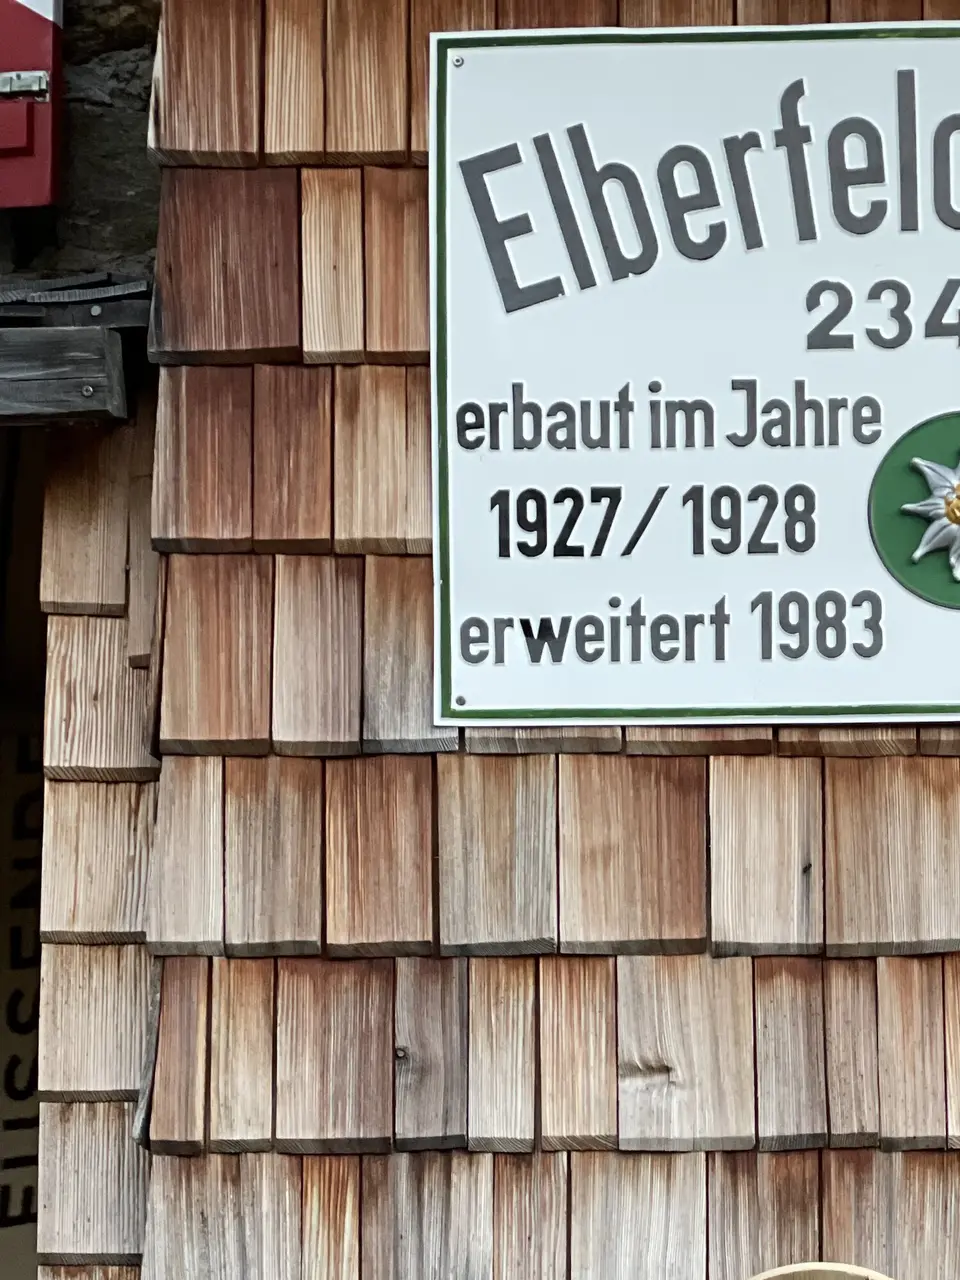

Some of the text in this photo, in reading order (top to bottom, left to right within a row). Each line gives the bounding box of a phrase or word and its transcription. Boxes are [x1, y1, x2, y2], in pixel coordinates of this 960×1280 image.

[455, 378, 883, 452] erbaut im Jahre
[489, 483, 817, 559] 1927/1928
[458, 590, 884, 665] erweitert 1983
